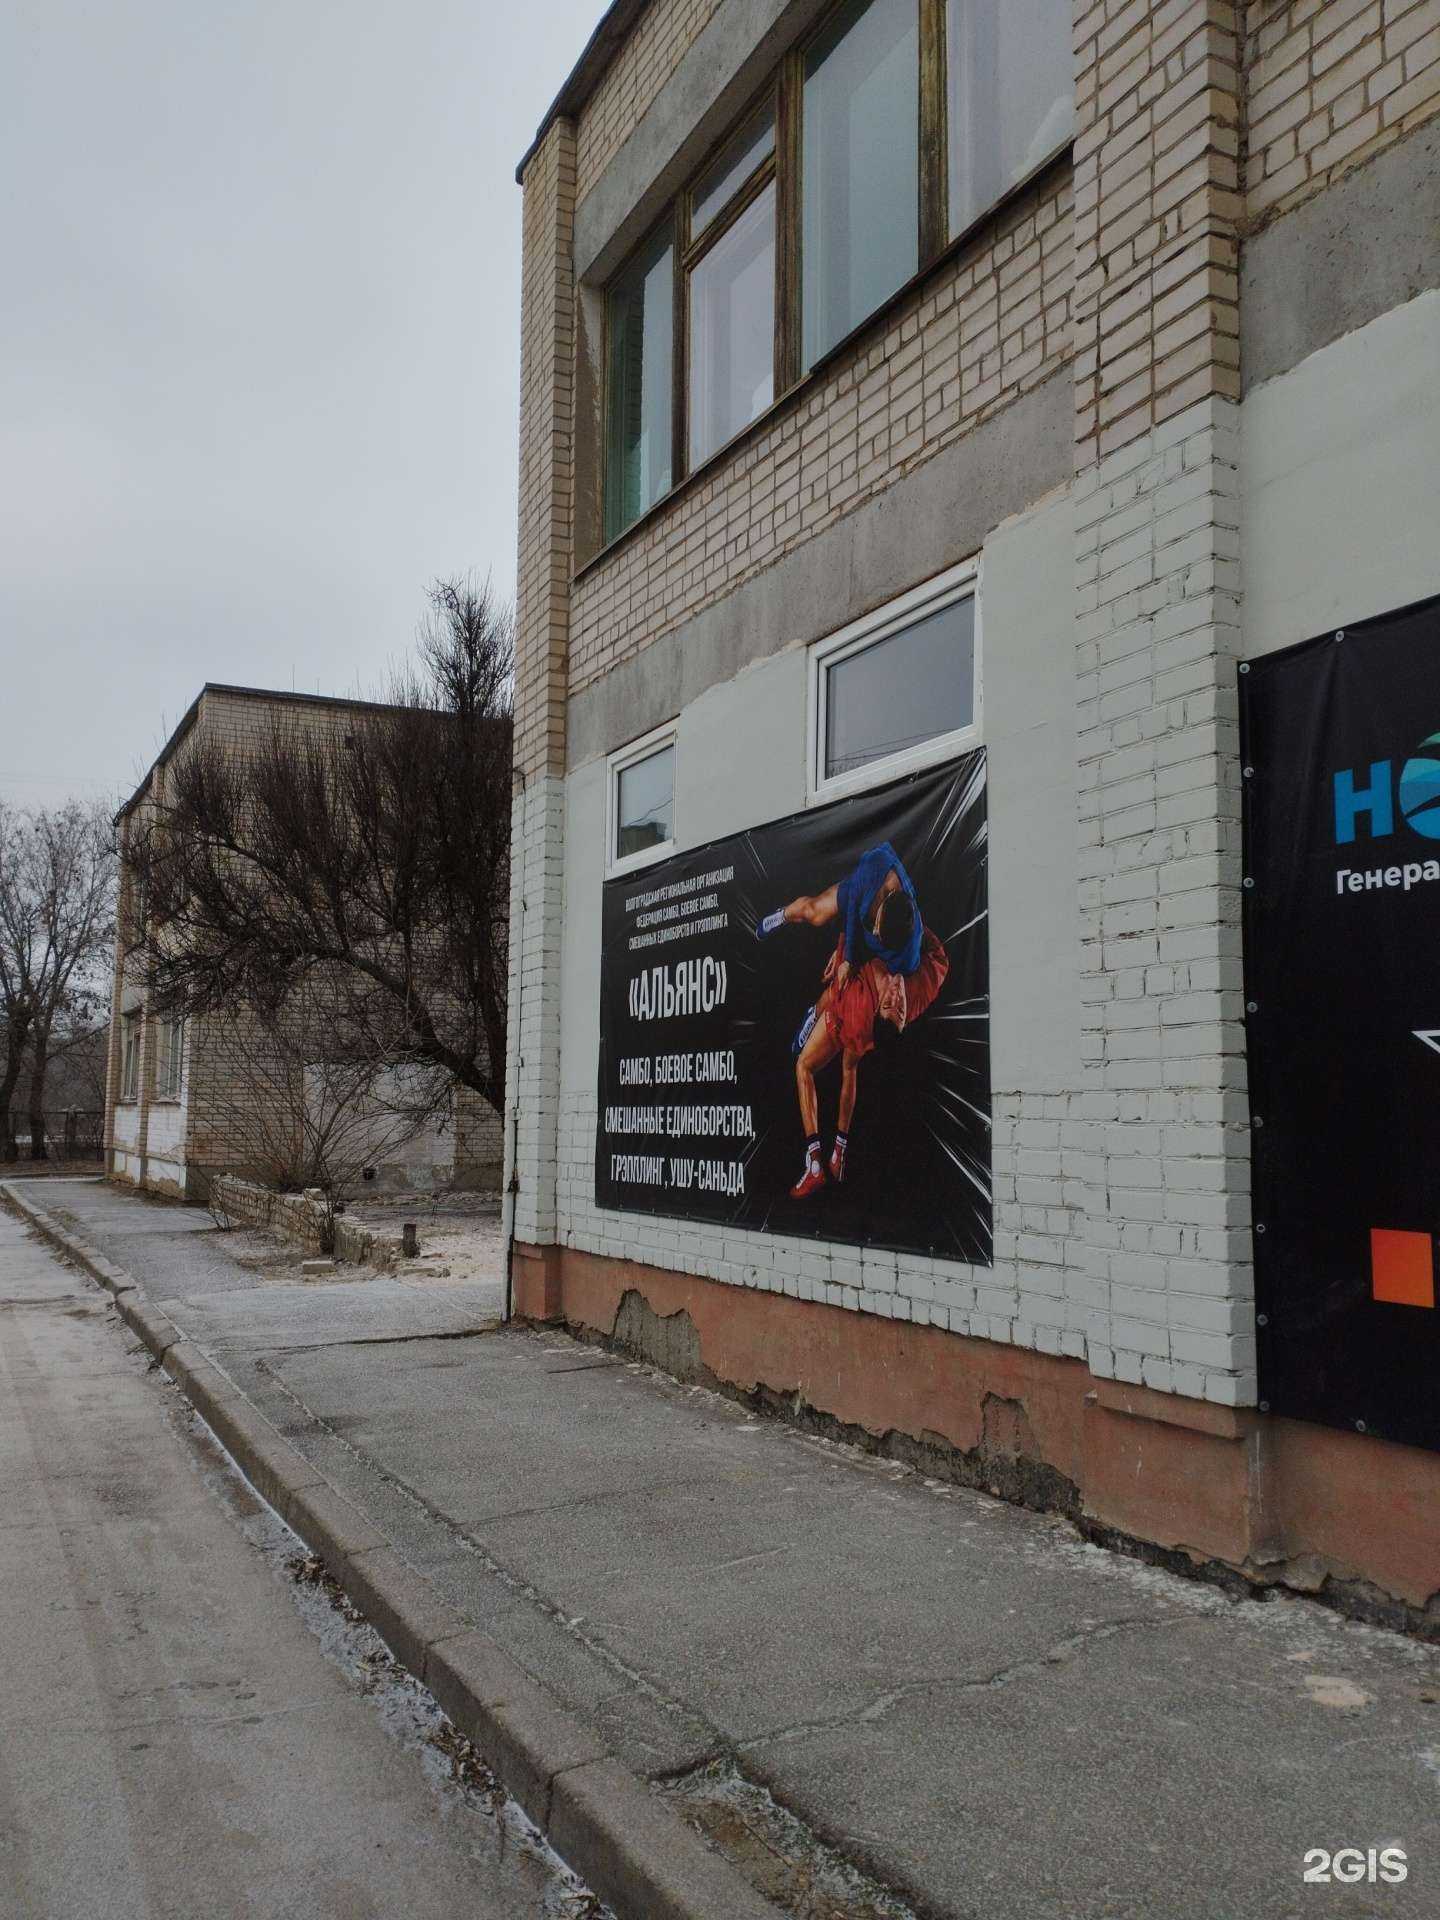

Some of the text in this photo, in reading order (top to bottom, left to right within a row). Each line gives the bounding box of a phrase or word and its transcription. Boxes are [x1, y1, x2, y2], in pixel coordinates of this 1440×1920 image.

[660, 877, 696, 901] РЕГИОНАЛЬНАЯ
[696, 866, 734, 890] ОРГАНИЗАЦИЯ
[628, 912, 728, 951] СМЕШАННЫХ ЕДИНОБОРСТВ И ГРЭППЛИНГА
[636, 909, 662, 928] ФЕДЕРАЦИЯ
[680, 898, 699, 916] БОЕВОЕ
[628, 955, 728, 1022] «АЛЬЯНС»
[619, 1050, 738, 1087] САМБО, БОЕВОЕ САМБО,
[605, 1105, 756, 1141] СМЕШАННЫЕ ЕДИНОБОРСТВА,
[670, 1158, 745, 1196] УШУ-САНЬДА
